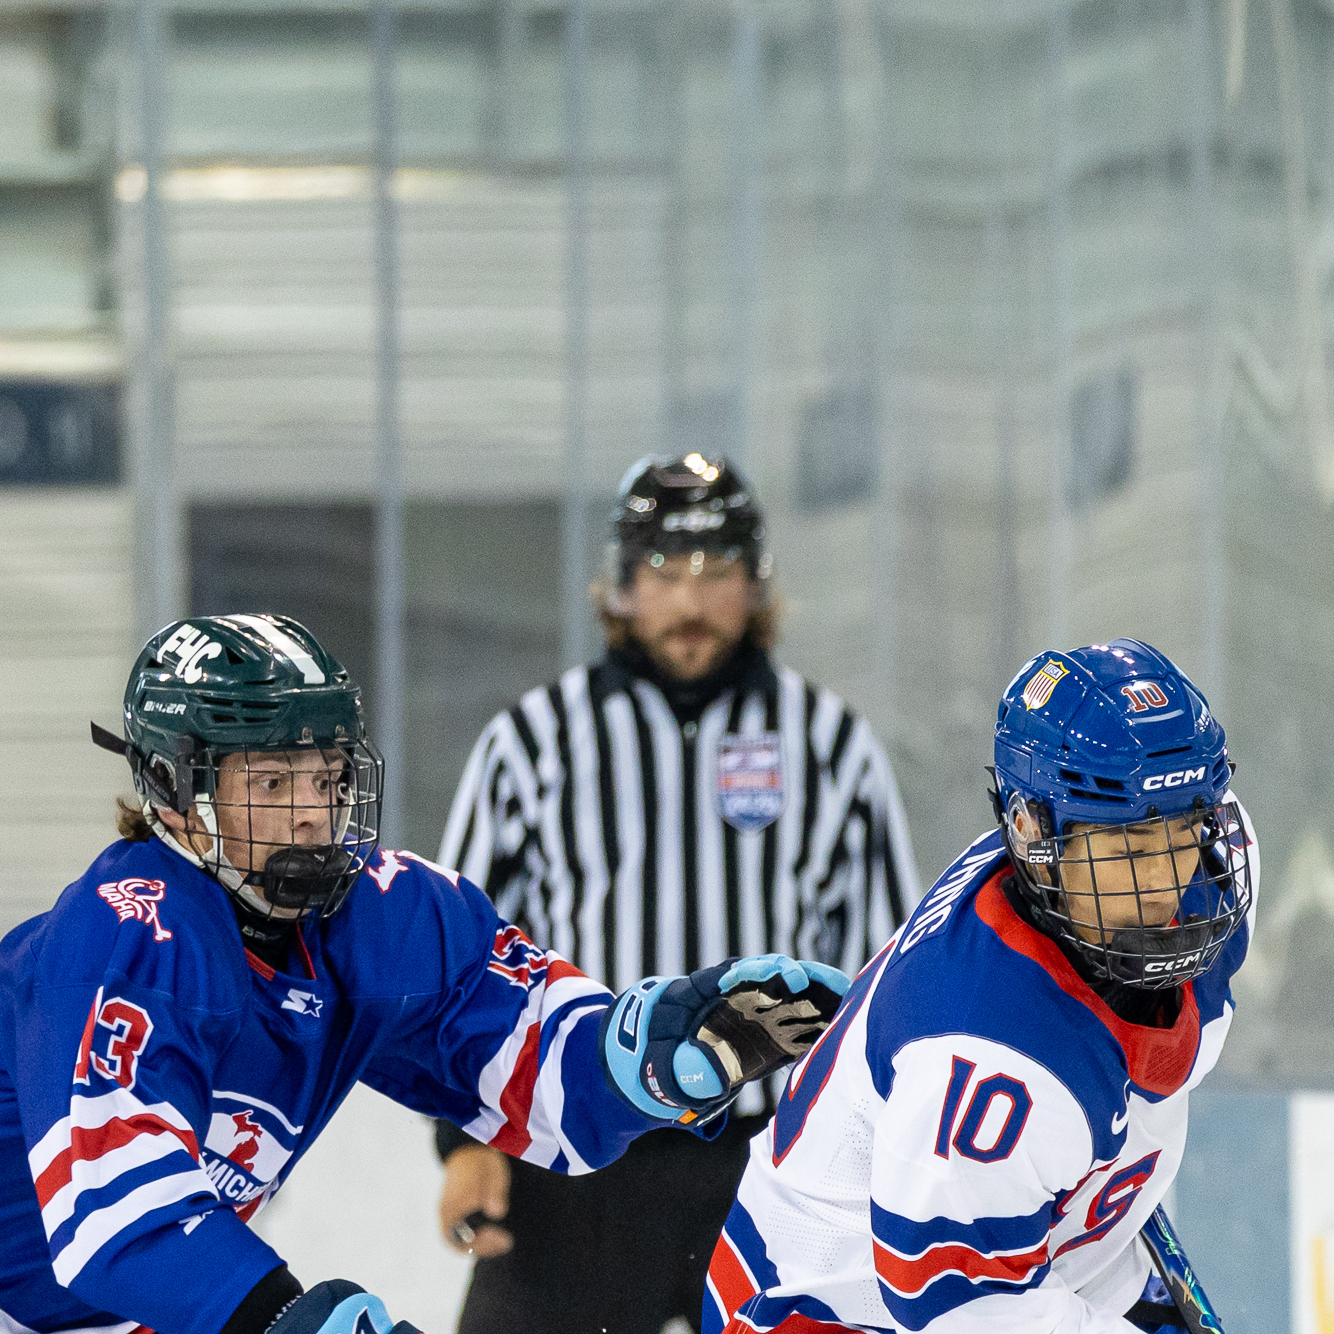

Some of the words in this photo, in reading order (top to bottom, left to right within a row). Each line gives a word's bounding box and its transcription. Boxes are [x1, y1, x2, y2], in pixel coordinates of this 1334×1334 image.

[1120, 681, 1170, 713] 10
[1142, 766, 1206, 791] CCM
[1028, 855, 1053, 864] CCM
[1144, 952, 1203, 973] CCM
[73, 985, 154, 1093] 13
[679, 1071, 704, 1084] CCM
[934, 1055, 1034, 1164] 10
